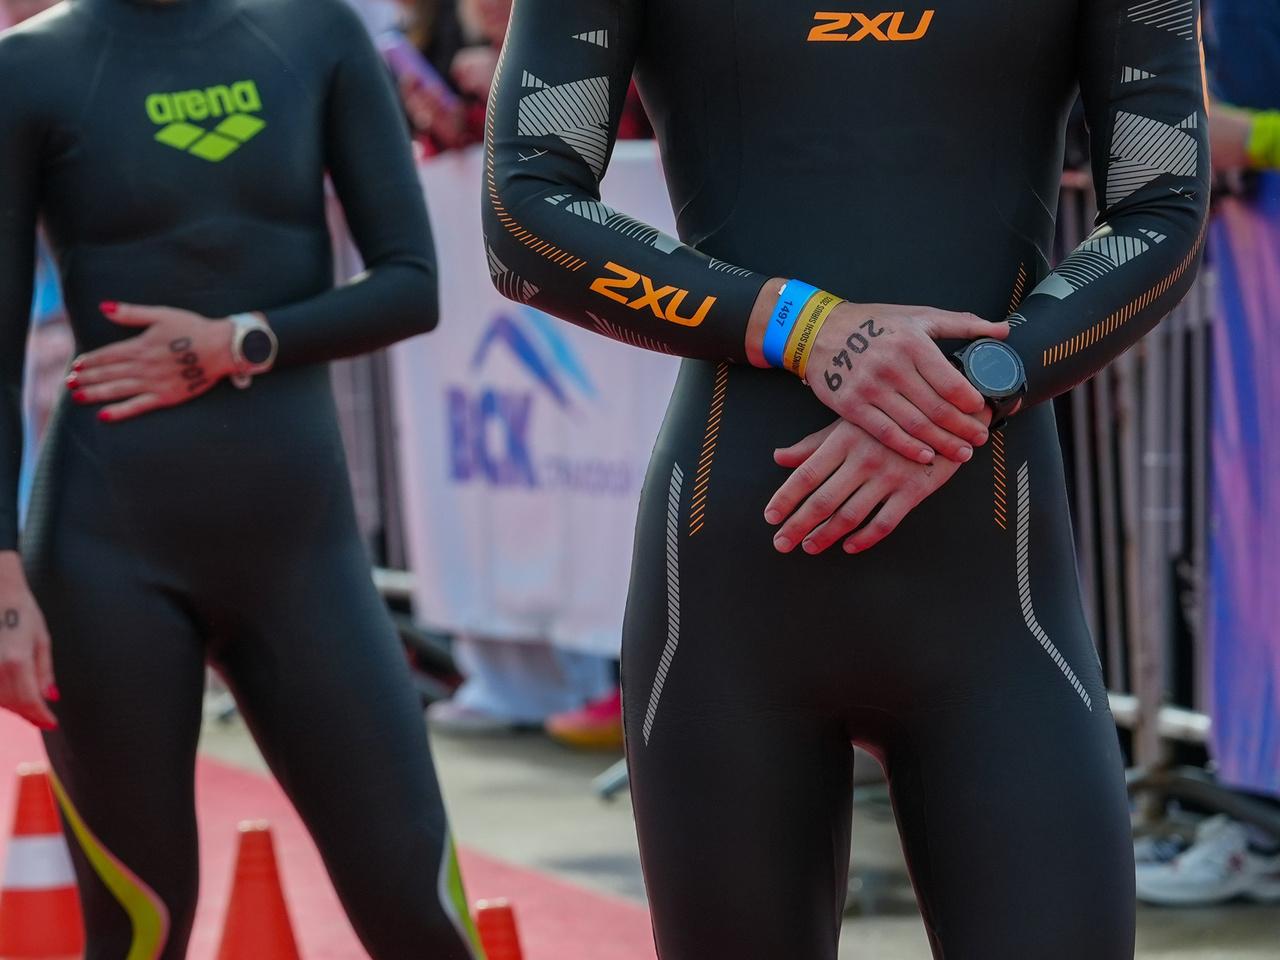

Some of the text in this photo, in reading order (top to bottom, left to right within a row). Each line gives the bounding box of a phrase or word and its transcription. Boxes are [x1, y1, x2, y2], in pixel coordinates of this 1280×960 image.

[807, 10, 935, 41] 2XU
[145, 80, 262, 124] arena
[589, 261, 717, 327] 2XU
[776, 301, 793, 327] 1497
[800, 322, 814, 343] SOCHI
[809, 305, 825, 324] SIRIUS
[824, 319, 885, 391] 2049
